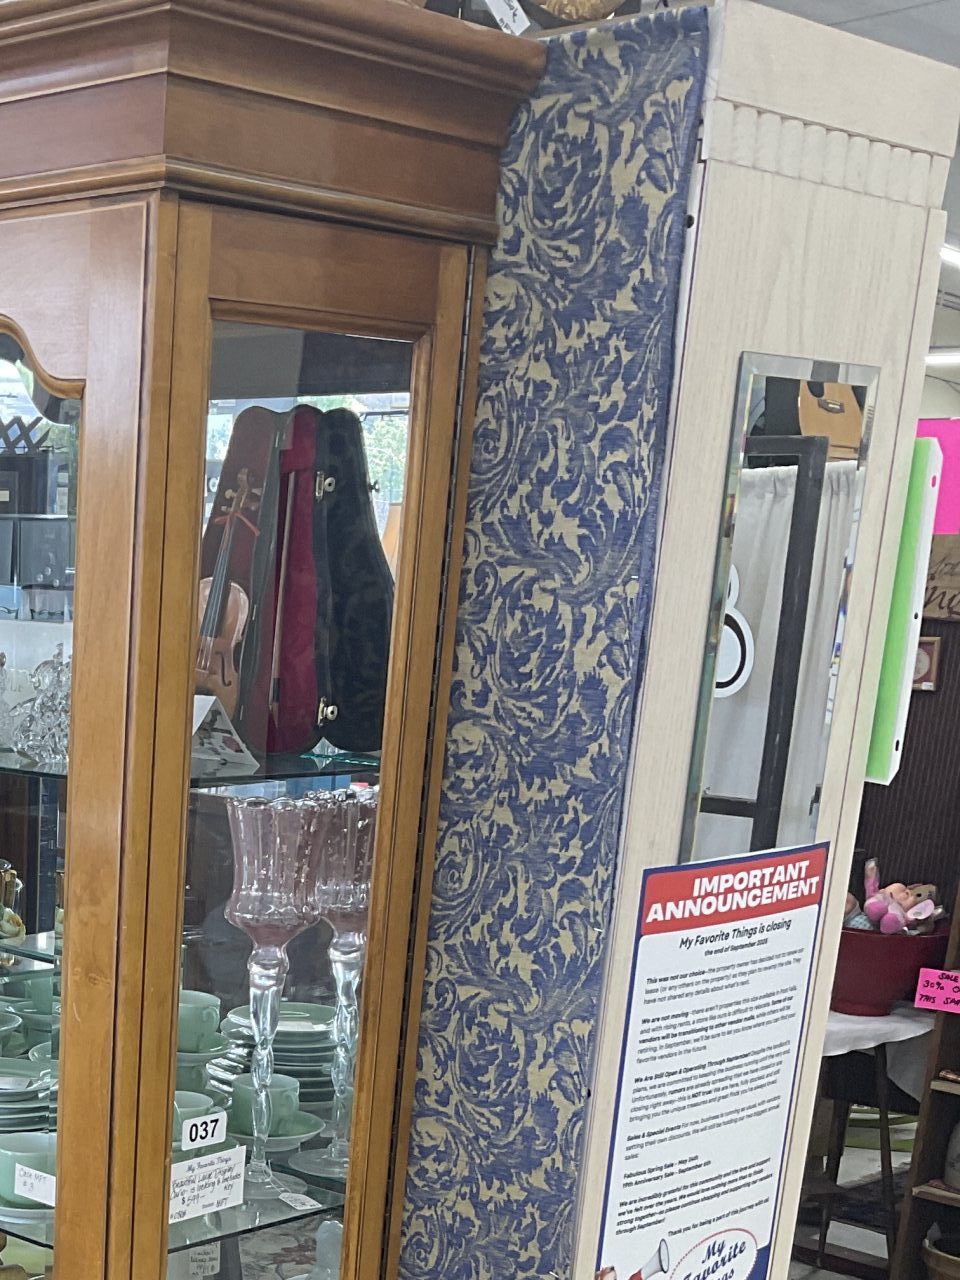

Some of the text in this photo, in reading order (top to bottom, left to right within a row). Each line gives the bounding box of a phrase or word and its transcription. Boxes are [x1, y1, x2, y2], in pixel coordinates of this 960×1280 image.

[693, 860, 809, 897] IMPORTANT
[645, 876, 820, 923] ANNOUNCEMENT
[679, 918, 792, 949] My Favorite Things is closing
[704, 948, 713, 957] the
[713, 947, 723, 956] end
[729, 941, 755, 954] September
[645, 976, 657, 985] This
[922, 979, 945, 991] 30%
[938, 972, 959, 983] SALE
[919, 993, 936, 1004] THIS
[638, 1034, 661, 1045] vendors
[660, 1032, 670, 1040] will
[677, 1024, 708, 1039] transitioning
[727, 1017, 743, 1026] vendor
[641, 1016, 650, 1025] We
[660, 1014, 670, 1022] not
[633, 1075, 643, 1084] We
[643, 1074, 653, 1082] Are
[653, 1071, 664, 1080] Still
[664, 1068, 677, 1078] Open
[682, 1062, 706, 1075] Operating
[706, 1057, 725, 1068] Through
[667, 1086, 686, 1095] rumors
[691, 1090, 701, 1099] NOT
[189, 1118, 219, 1143] 037
[626, 1132, 641, 1142] Sales
[645, 1126, 665, 1138] Special
[623, 1167, 647, 1181] Fabulous
[646, 1162, 663, 1175] Spring
[663, 1161, 674, 1170] Sale
[677, 1157, 687, 1166] May
[633, 1171, 663, 1188] Anniversary
[663, 1169, 674, 1178] Sale
[677, 1161, 703, 1175] September
[619, 1199, 628, 1207] We
[637, 1190, 662, 1205] incredibly
[661, 1185, 682, 1198] grateful
[689, 1180, 698, 1189] this
[698, 1172, 722, 1186] community
[722, 1170, 731, 1178] and
[731, 1167, 739, 1175] the
[739, 1164, 748, 1172] love
[633, 1204, 643, 1213] felt
[643, 1202, 654, 1211] over
[655, 1199, 663, 1207] the
[686, 1189, 700, 1198] would
[700, 1185, 710, 1193] love
[710, 1180, 727, 1191] nothing
[727, 1177, 738, 1185] more
[615, 1216, 634, 1228] strong
[664, 1203, 681, 1214] please
[680, 1197, 700, 1208] continue
[700, 1190, 720, 1203] shopping
[729, 1181, 751, 1193] supporting
[667, 1226, 682, 1237] Thank
[682, 1224, 691, 1233] you
[698, 1218, 712, 1228] being
[715, 1213, 725, 1221] part
[725, 1210, 730, 1218] of
[730, 1208, 739, 1216] this
[738, 1203, 754, 1214] journey
[754, 1198, 763, 1207] with
[614, 1223, 636, 1238] through
[701, 1240, 726, 1265] My
